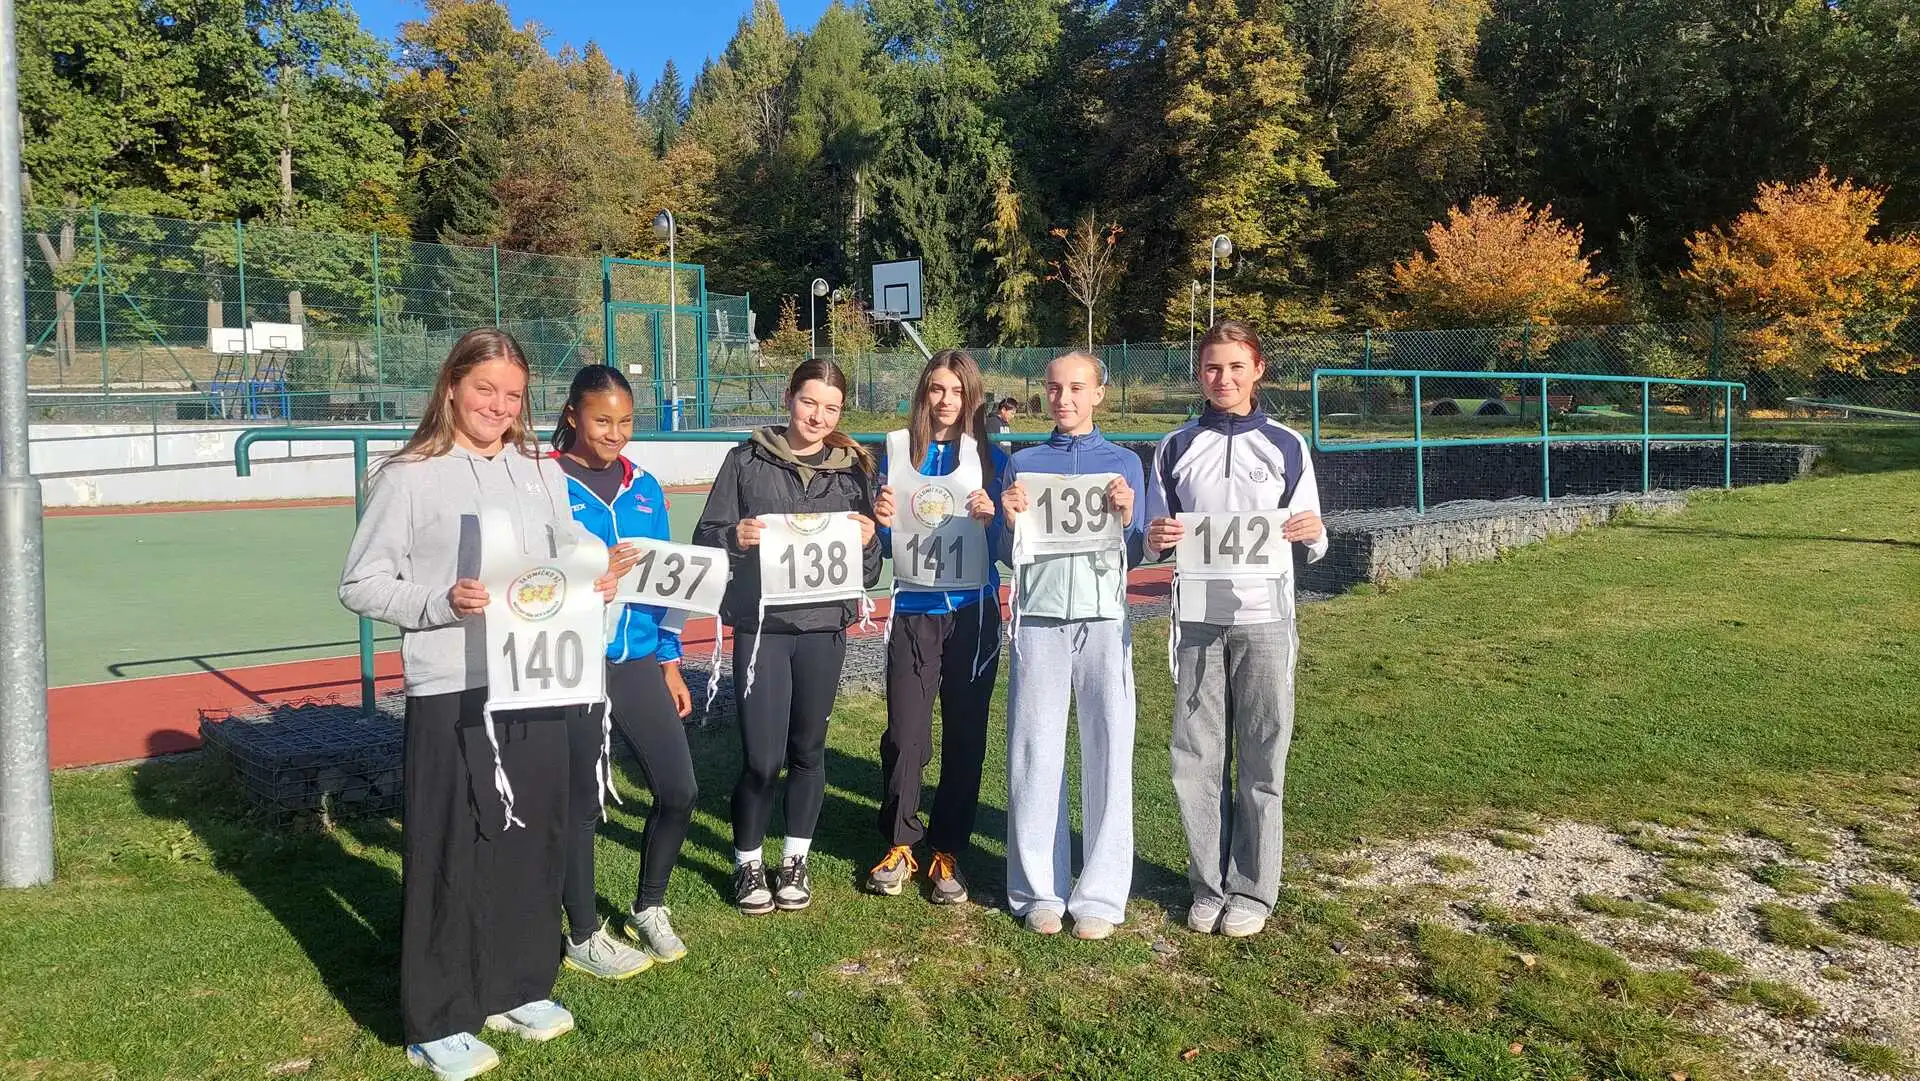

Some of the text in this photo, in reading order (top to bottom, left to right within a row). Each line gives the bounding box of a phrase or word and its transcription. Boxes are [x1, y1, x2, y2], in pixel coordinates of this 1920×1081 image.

[1037, 486, 1108, 534] 139
[780, 540, 848, 589] 138
[906, 533, 963, 579] 141
[1195, 516, 1270, 565] 142
[635, 549, 712, 600] 137
[502, 630, 584, 691] 140
